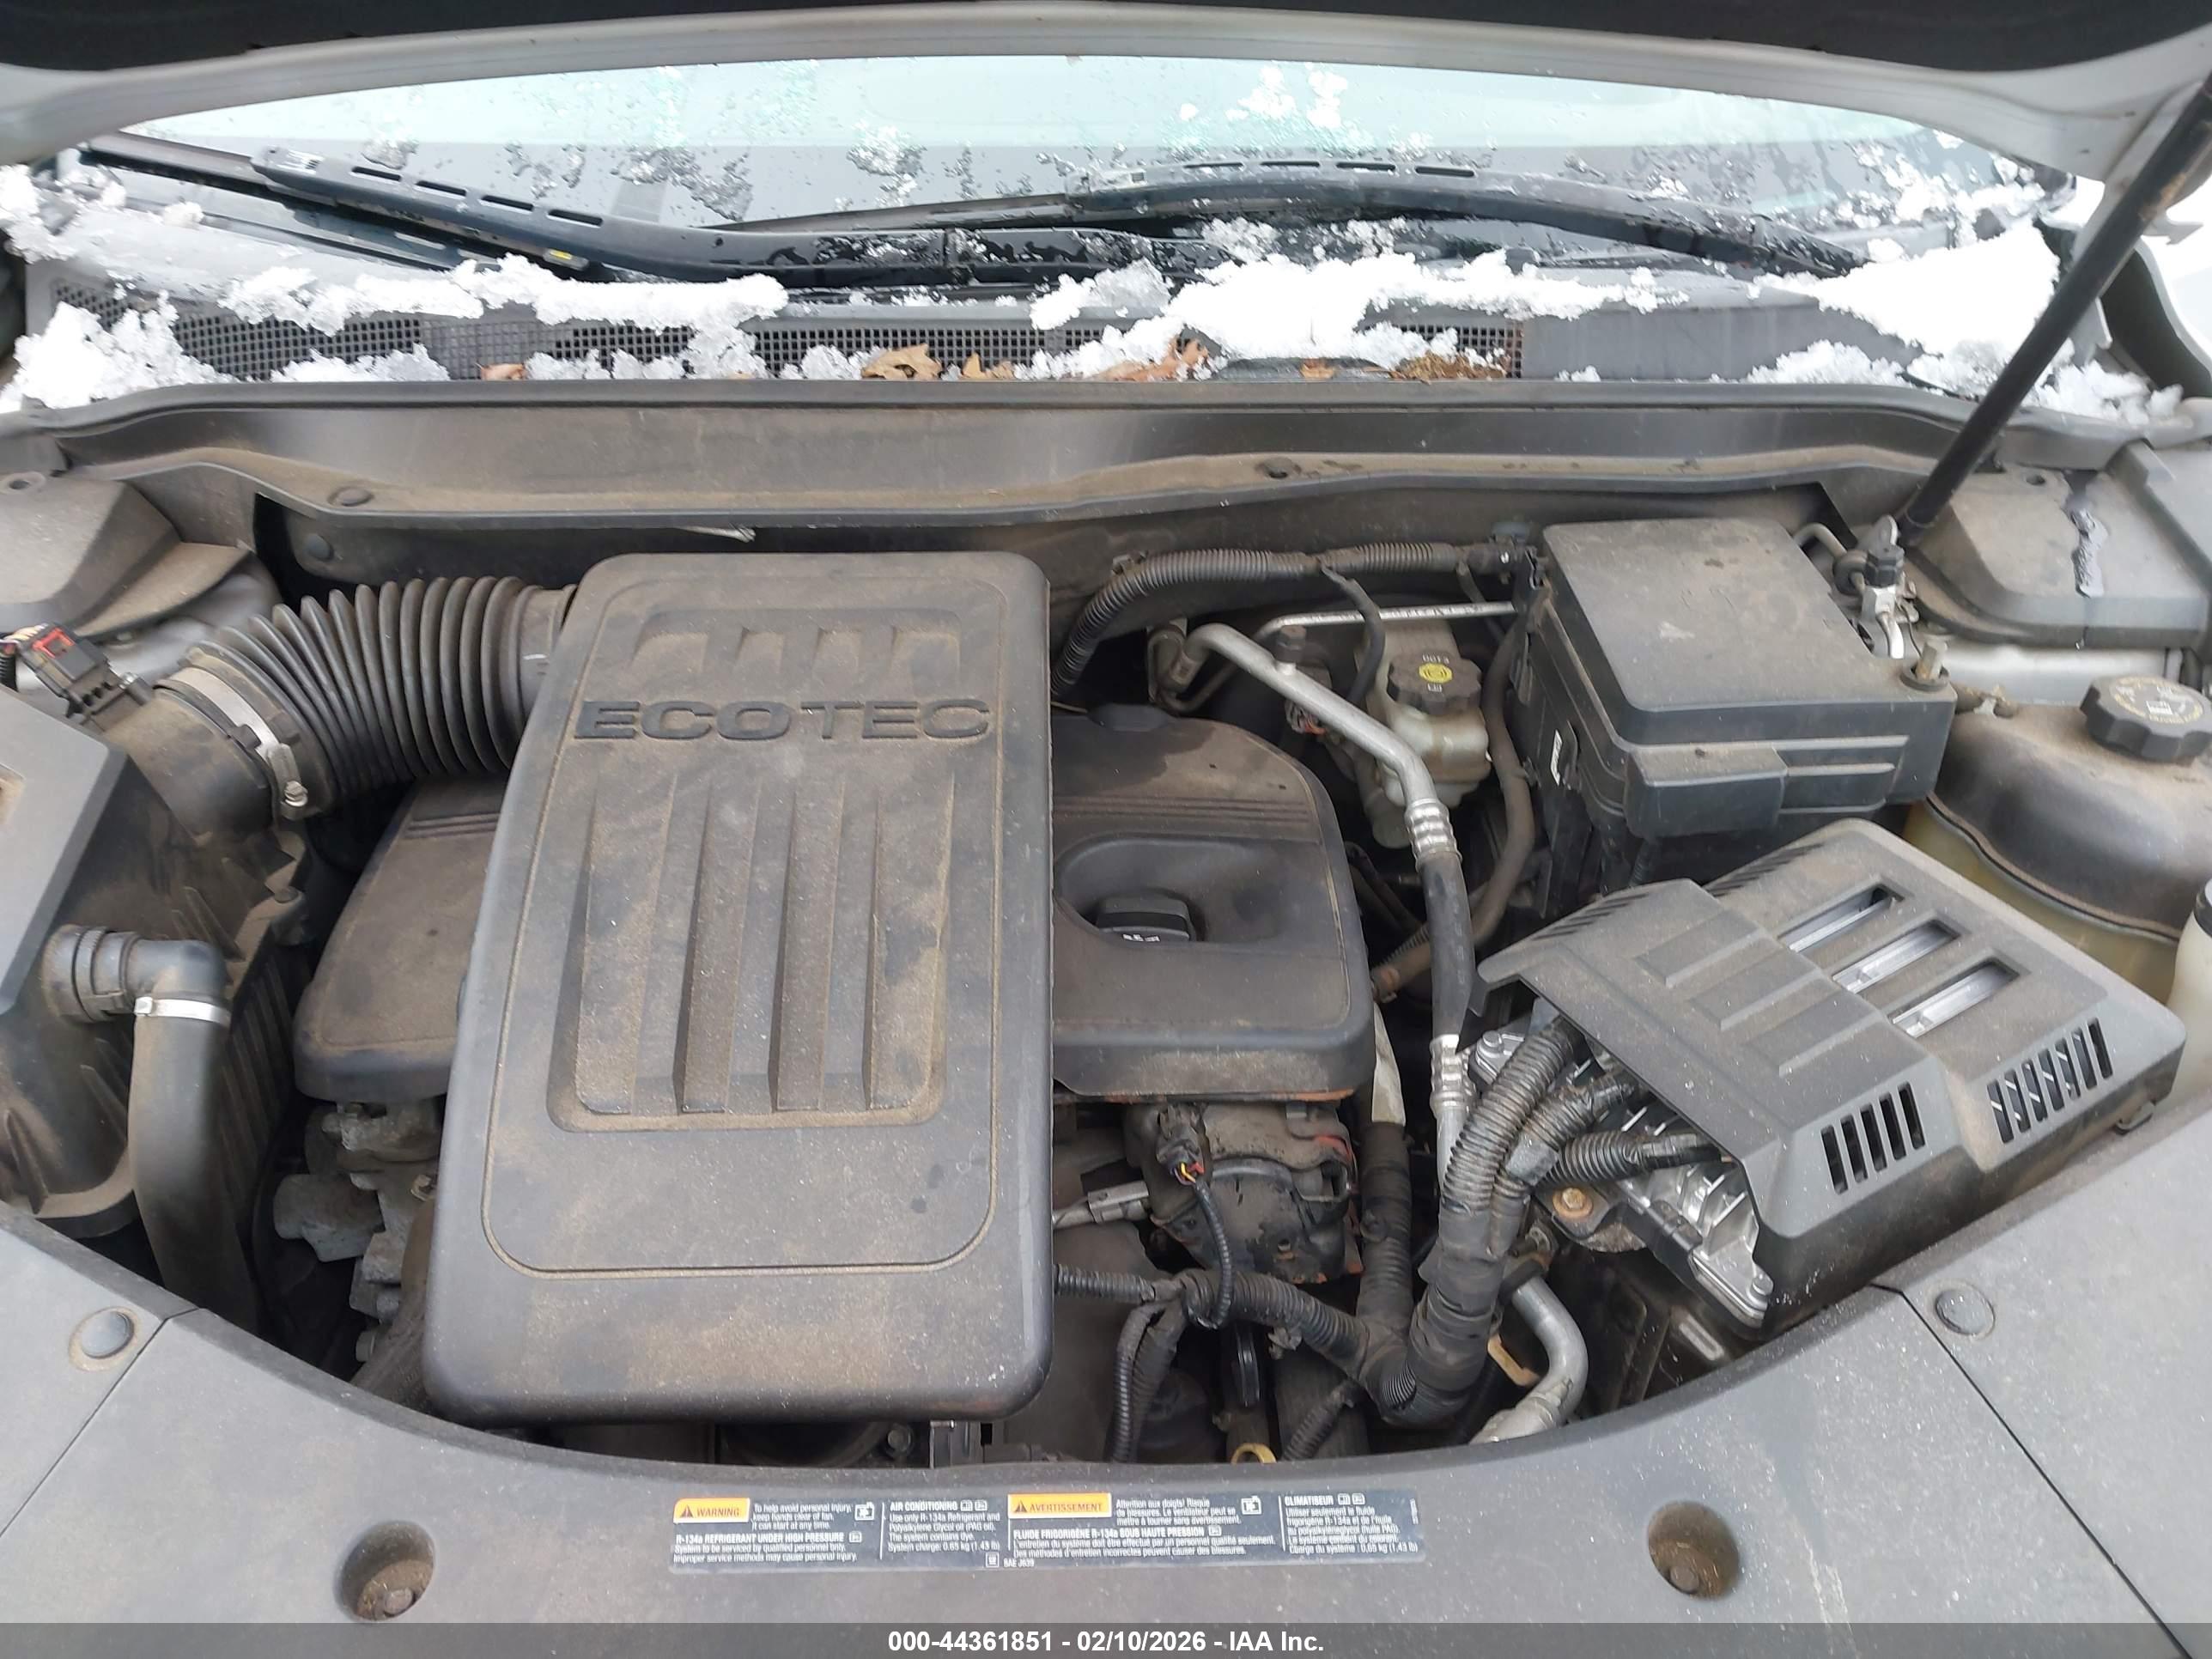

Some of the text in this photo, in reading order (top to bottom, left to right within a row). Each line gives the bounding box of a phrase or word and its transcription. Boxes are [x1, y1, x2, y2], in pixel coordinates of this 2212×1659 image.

[574, 699, 990, 740] ECOTEC
[1285, 1496, 1334, 1505] CLIMATISEUR
[780, 1504, 799, 1513] avoid
[799, 1504, 830, 1513] personal
[890, 1501, 958, 1511] AIR CONDITIONING
[1030, 1504, 1103, 1513] AVERTISSEMENT
[696, 1508, 739, 1517] WARNING
[752, 1513, 769, 1522] keep
[890, 1513, 903, 1522] Use
[987, 1513, 1000, 1522] and
[889, 1532, 902, 1542] The
[1013, 1529, 1040, 1539] FLUIDE
[1141, 1528, 1166, 1537] HAUTE
[1168, 1527, 1204, 1537] PRESSION
[677, 1533, 844, 1544] R-134a REFRIGERANT UNDER HIGH PRESSURE
